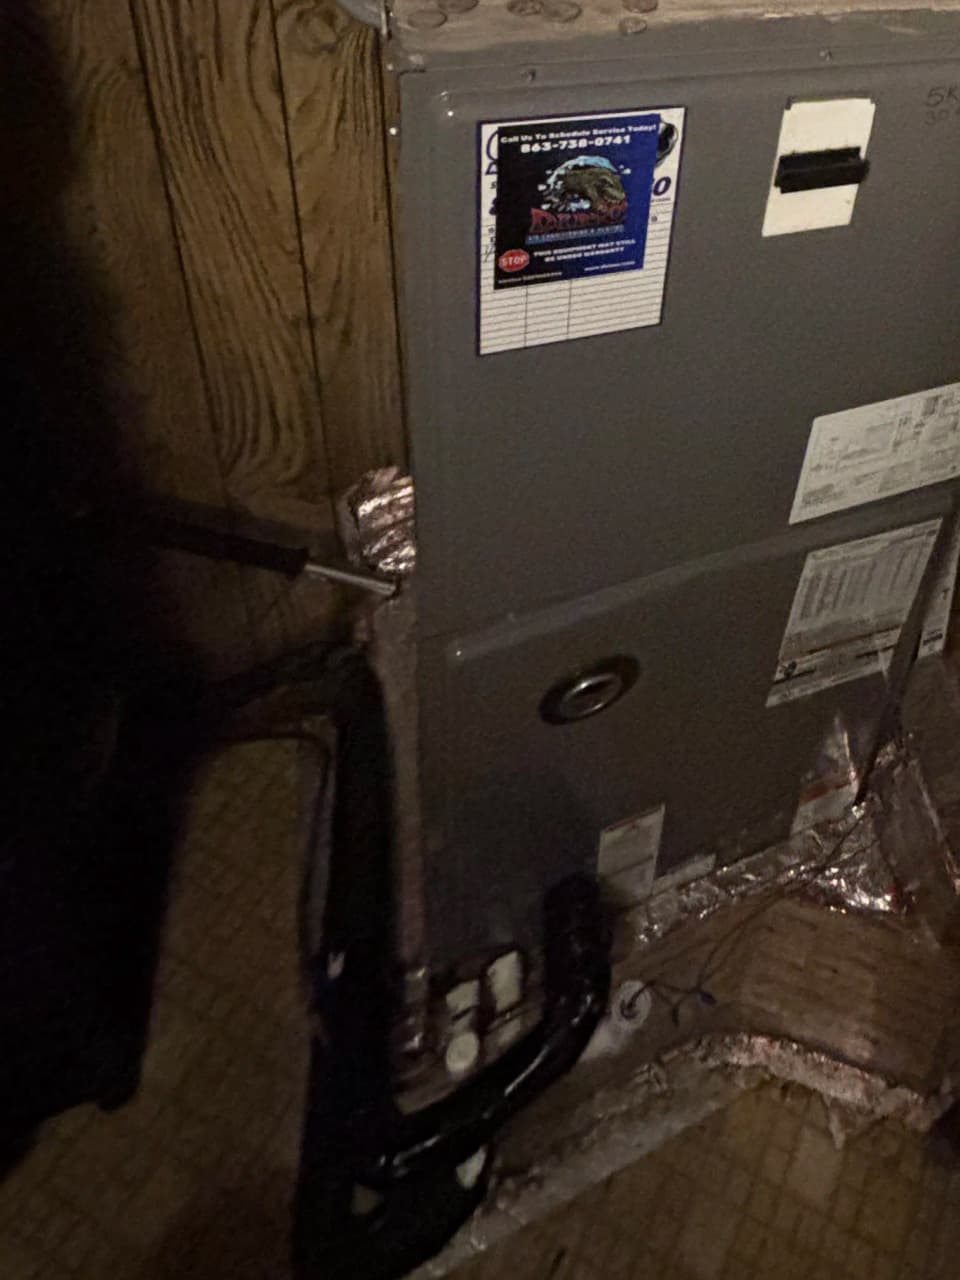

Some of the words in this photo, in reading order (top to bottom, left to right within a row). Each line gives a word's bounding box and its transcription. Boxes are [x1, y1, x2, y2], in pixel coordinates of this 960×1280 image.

[500, 135, 519, 144] Call
[548, 130, 590, 139] Schedule
[592, 127, 626, 135] Service
[627, 124, 657, 132] Today!
[520, 135, 631, 154] 863-738-0741
[501, 255, 528, 267] STOP
